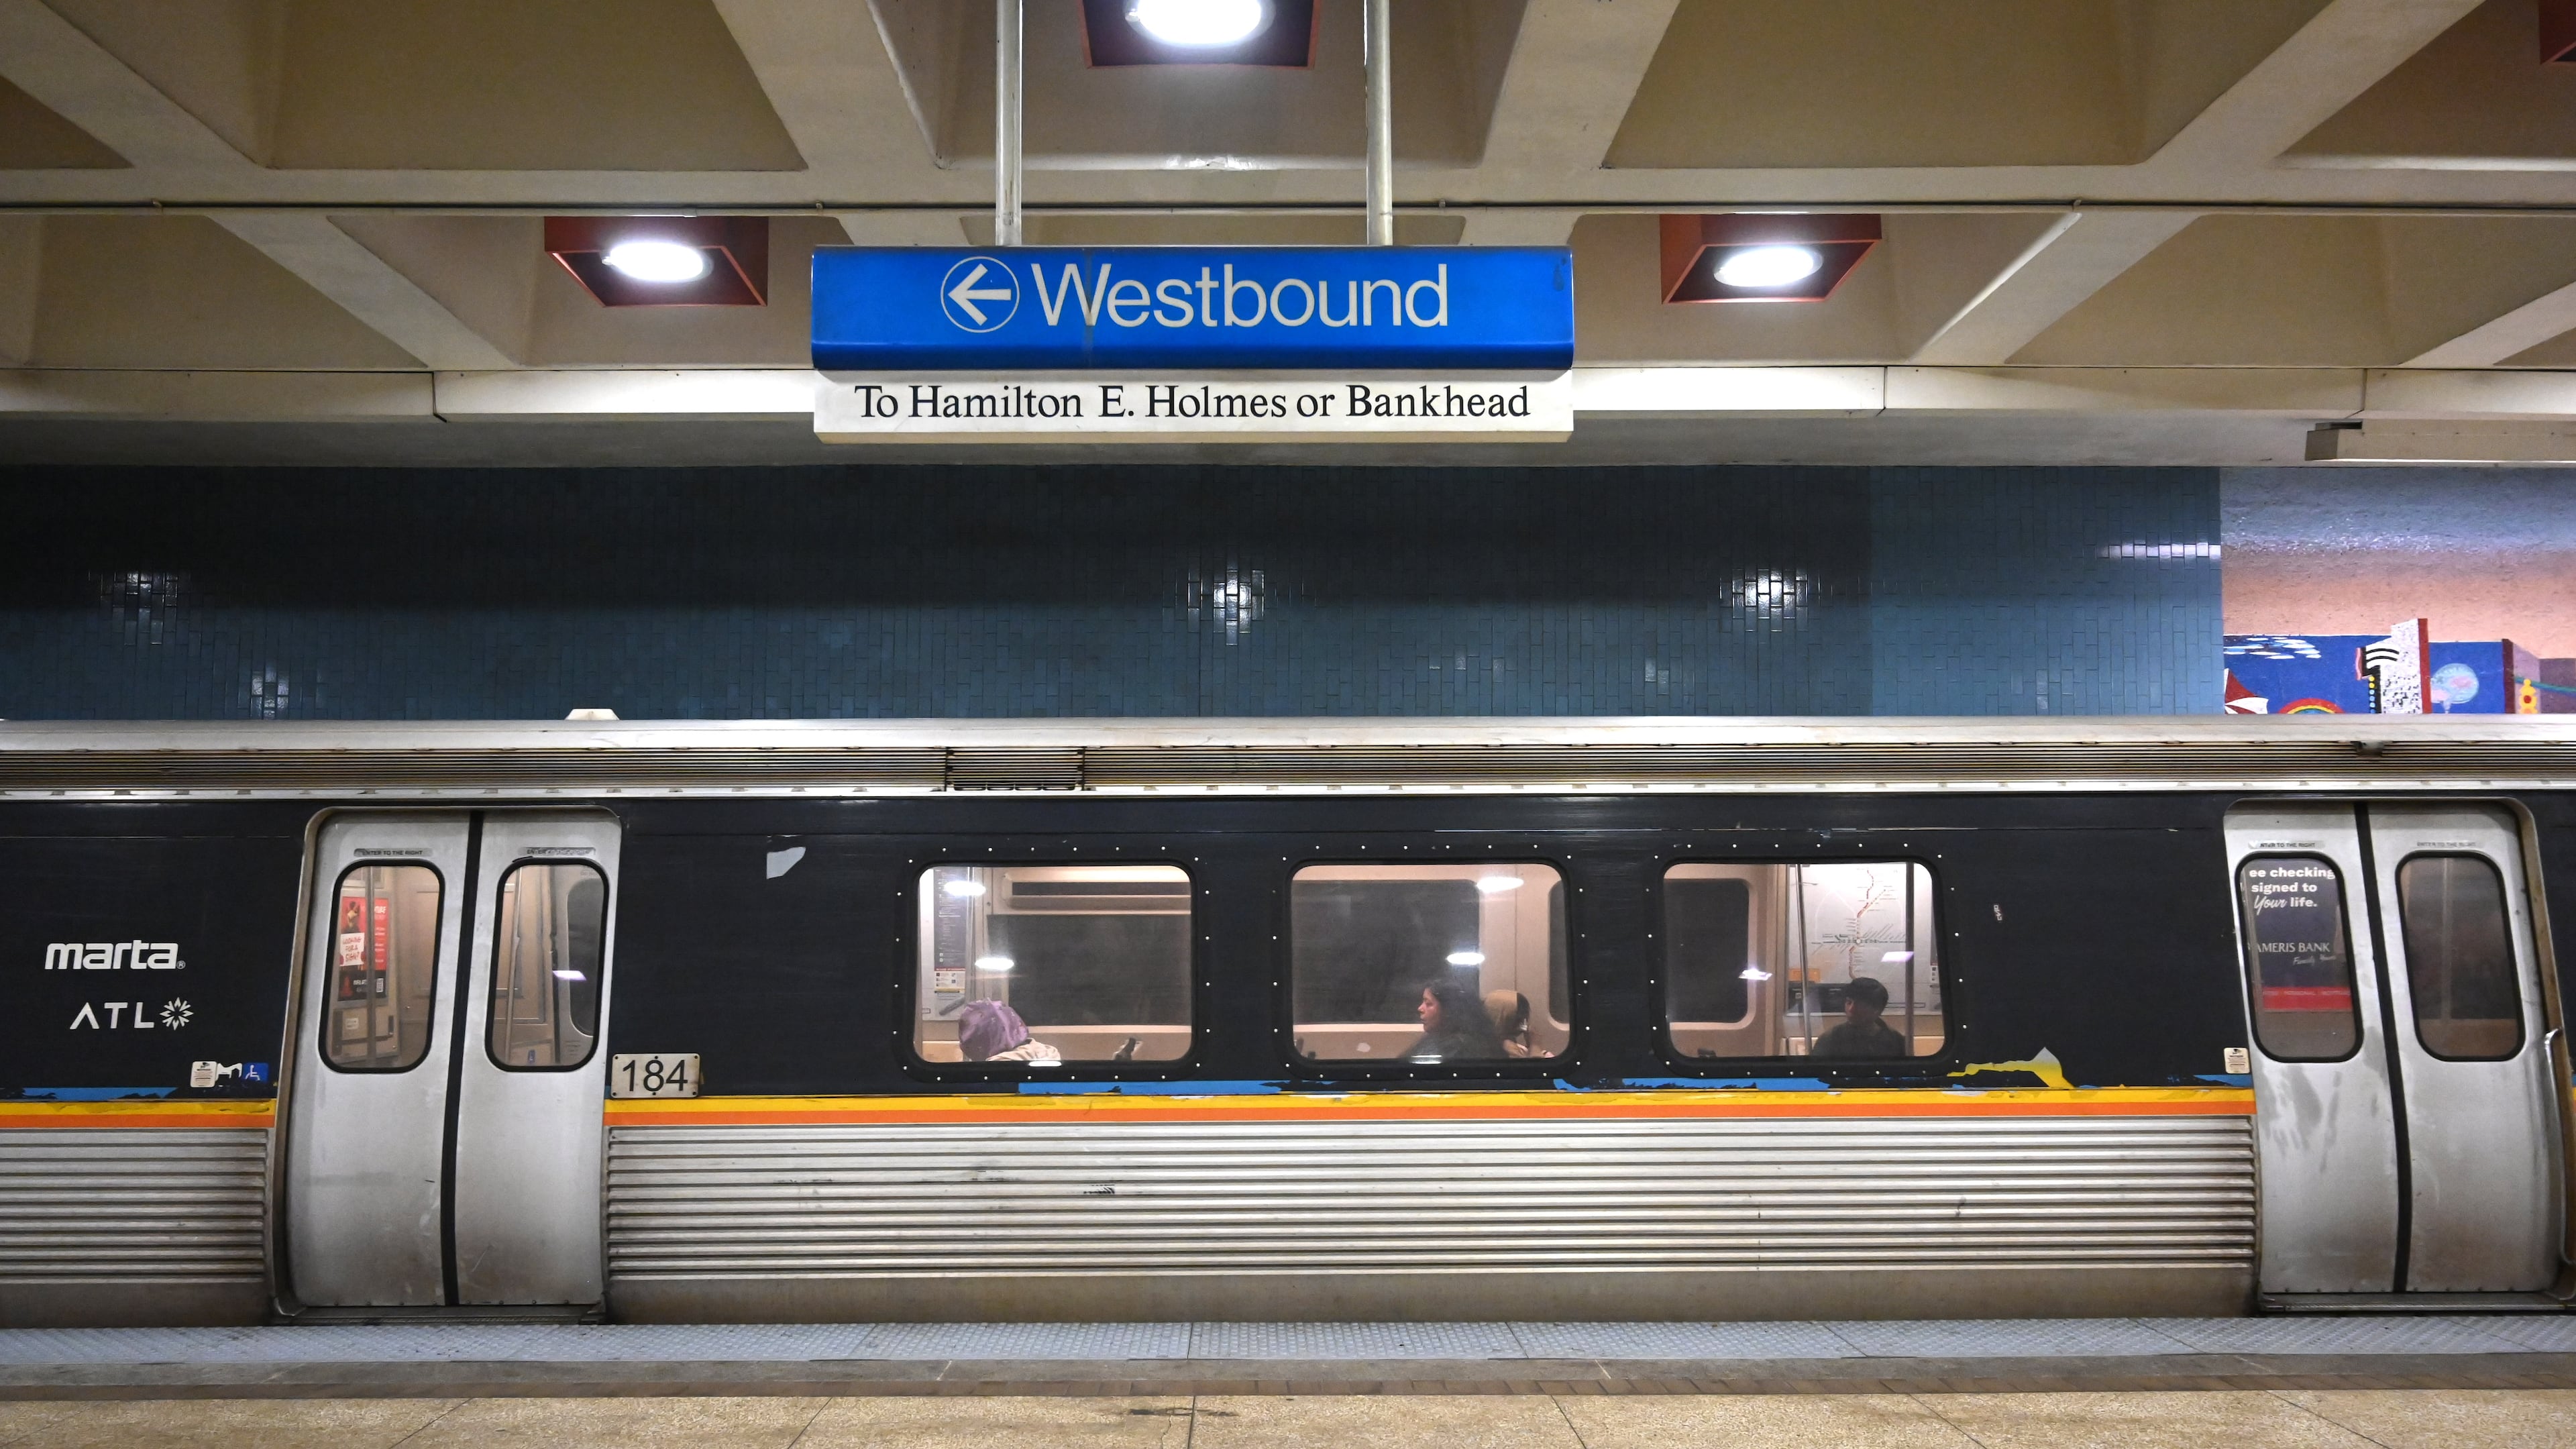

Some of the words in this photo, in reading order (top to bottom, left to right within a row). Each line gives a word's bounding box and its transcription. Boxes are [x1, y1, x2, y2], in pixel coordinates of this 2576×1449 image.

[1031, 263, 1448, 327] Westbound
[854, 385, 898, 418] To
[908, 385, 1084, 418] Hamilton
[1098, 385, 1134, 417] E.
[1145, 384, 1287, 418] Holmes
[1297, 394, 1335, 417] or
[1346, 384, 1531, 417] Bankhead
[2269, 866, 2336, 880] checking
[2251, 881, 2299, 895] signed
[2302, 882, 2318, 892] to
[2253, 894, 2288, 916] Your
[2290, 896, 2318, 908] life.
[2298, 942, 2330, 953] BANK
[69, 1002, 155, 1030] ATL
[623, 1059, 688, 1091] 184
